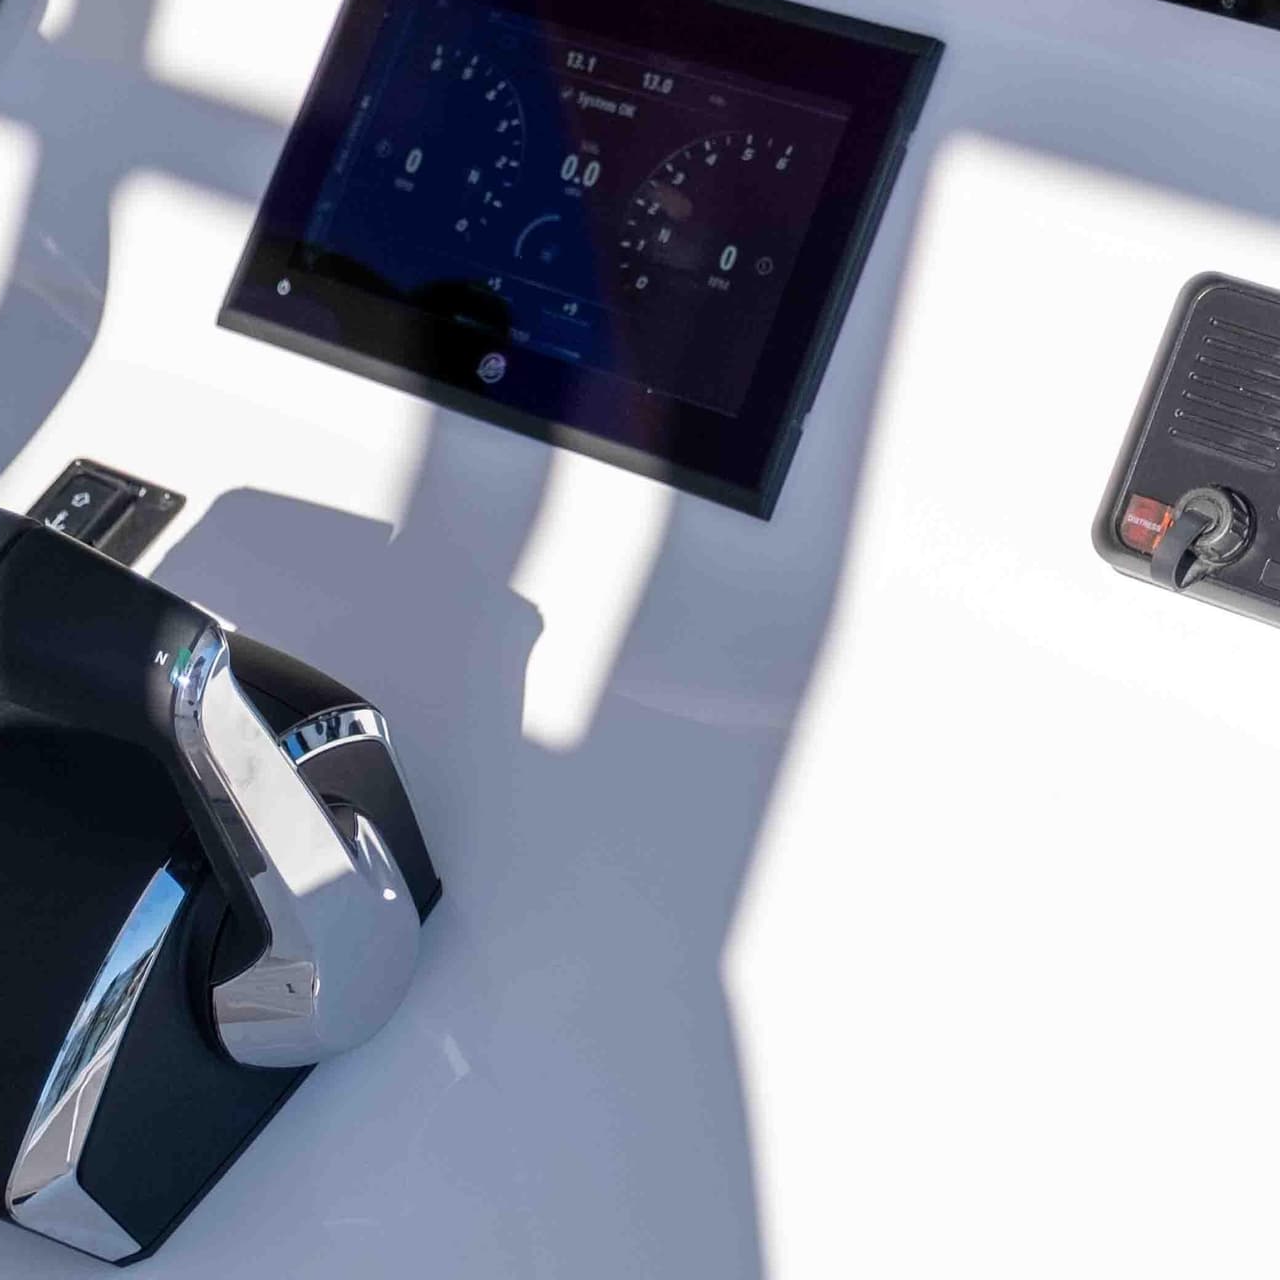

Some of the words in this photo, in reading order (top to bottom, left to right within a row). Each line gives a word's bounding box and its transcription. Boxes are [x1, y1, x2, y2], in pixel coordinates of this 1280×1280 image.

[404, 146, 424, 175] 0
[560, 152, 601, 188] 0.0
[719, 243, 738, 272] 0
[154, 650, 169, 666] N
